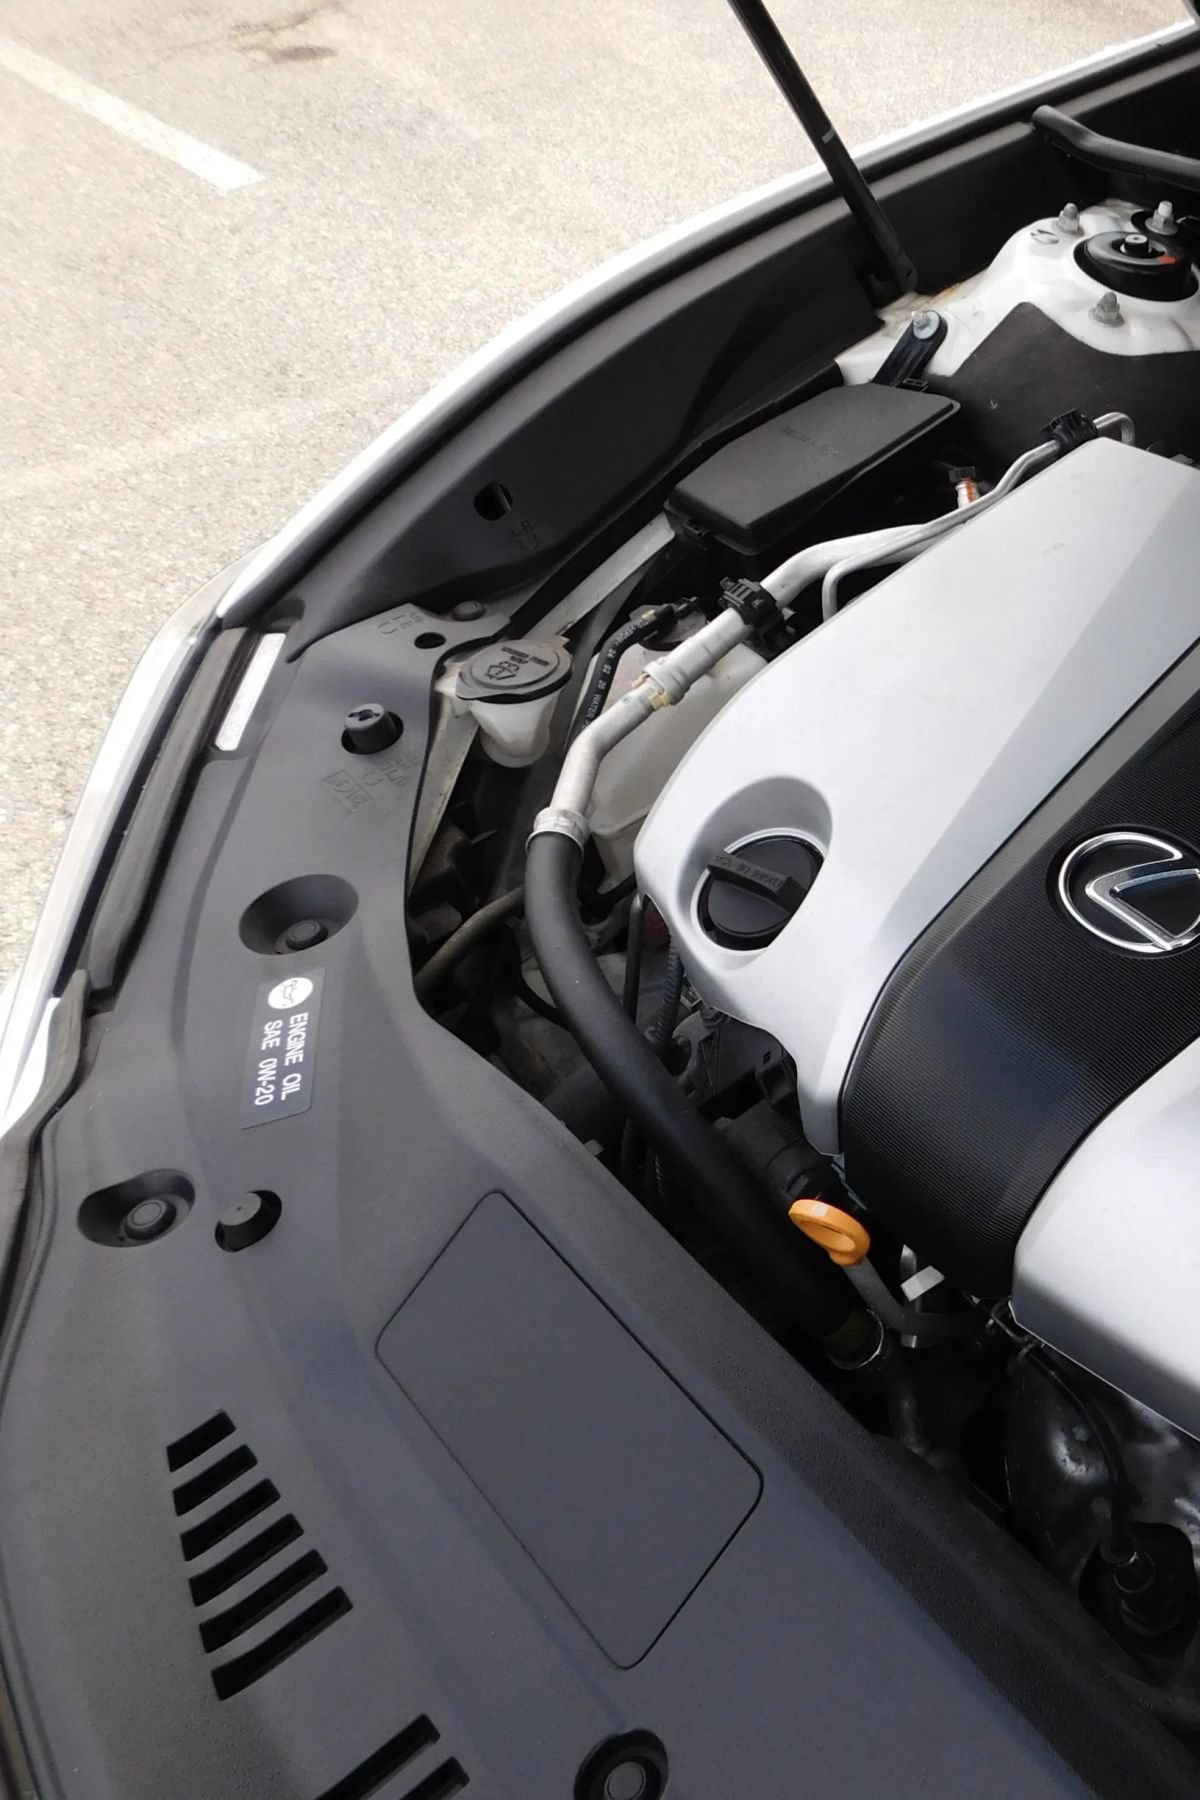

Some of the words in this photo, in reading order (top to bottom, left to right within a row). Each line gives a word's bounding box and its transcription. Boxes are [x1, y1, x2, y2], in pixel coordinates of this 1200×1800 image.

[261, 1019, 283, 1051] SAE
[284, 1012, 309, 1066] ENGINE
[254, 1058, 278, 1106] 0W-20
[280, 1073, 302, 1101] OIL
